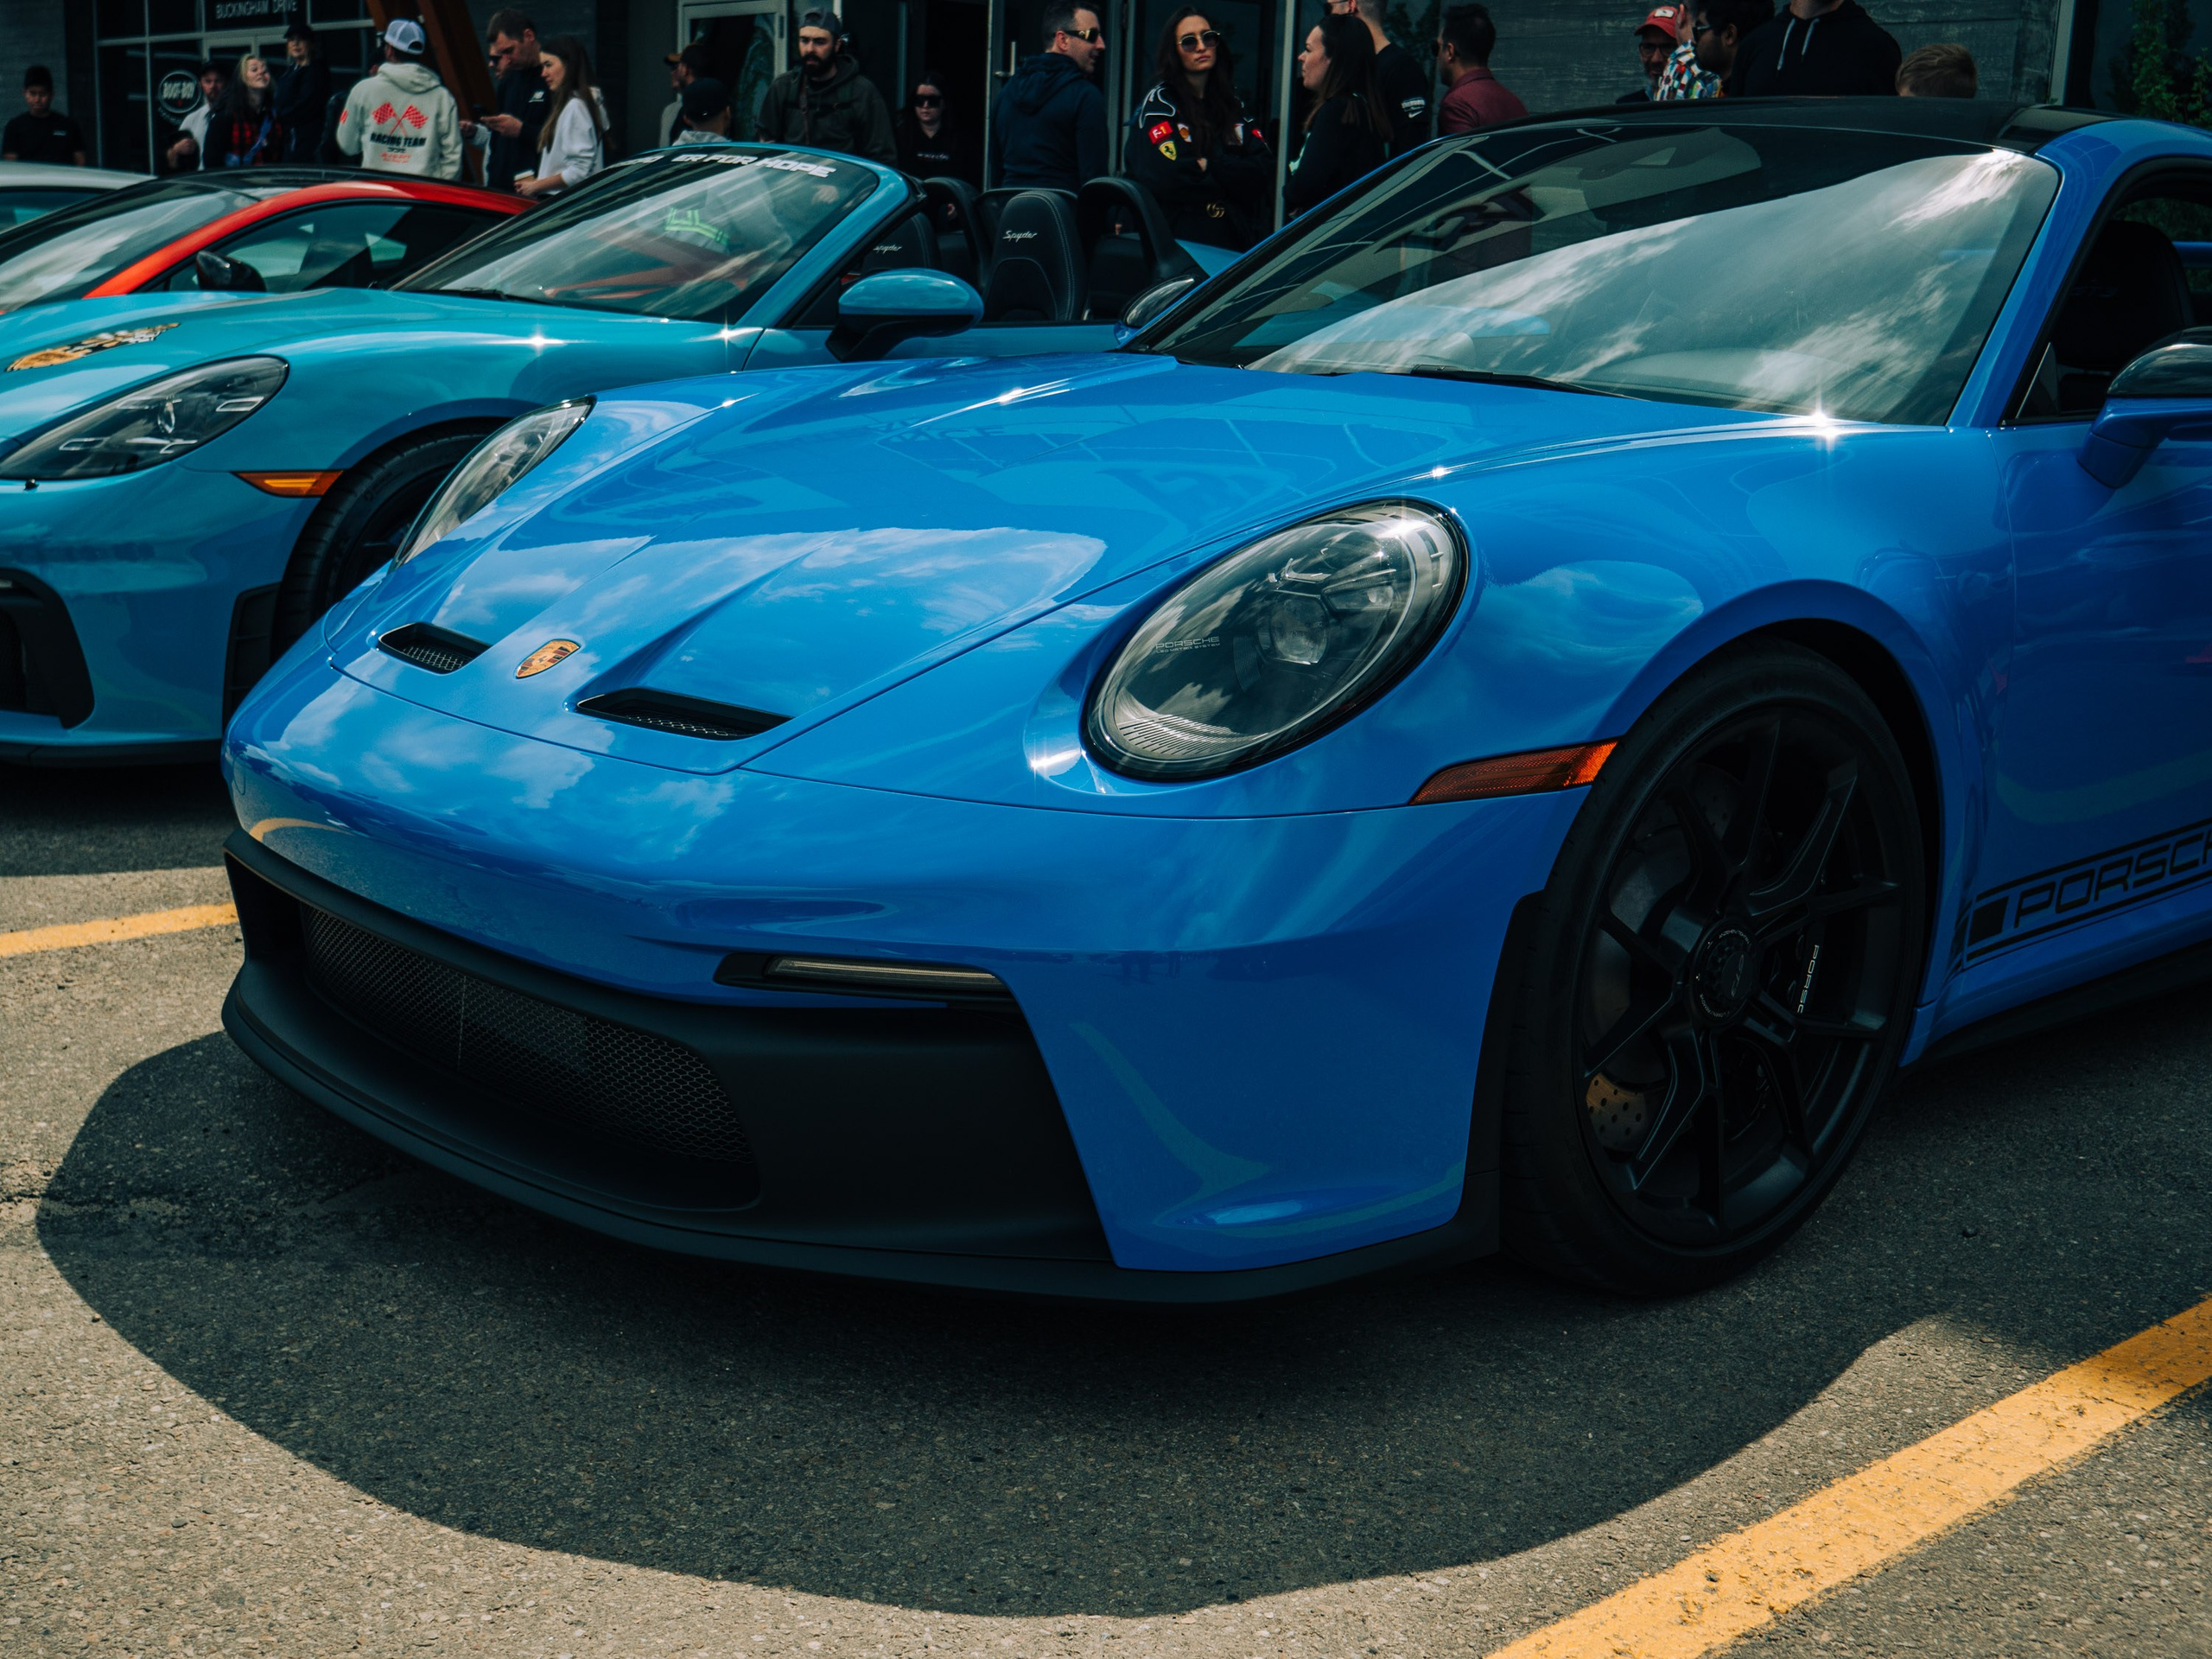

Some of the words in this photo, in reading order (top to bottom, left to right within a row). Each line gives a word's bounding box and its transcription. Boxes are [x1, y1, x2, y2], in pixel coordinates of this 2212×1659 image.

[215, 0, 270, 19] BUCKINGHAM
[272, 0, 298, 14] DRIVE
[370, 132, 402, 146] RACING
[403, 137, 427, 148] TEAM
[703, 154, 758, 165] FOR
[755, 157, 836, 178] HOPE
[1002, 230, 1038, 243] Spyder
[1155, 636, 1220, 650] PORSCHE
